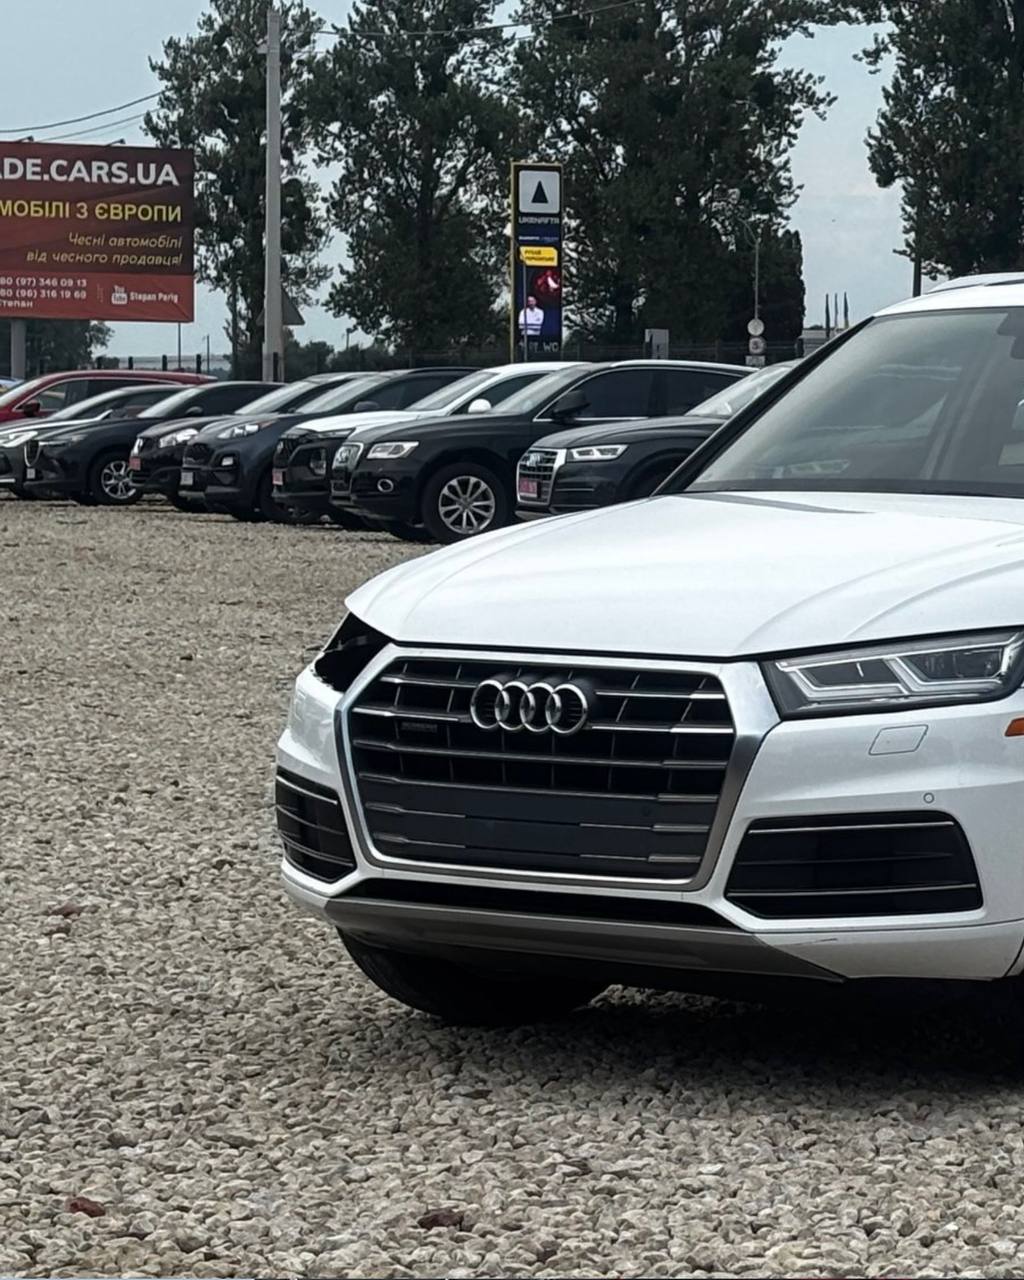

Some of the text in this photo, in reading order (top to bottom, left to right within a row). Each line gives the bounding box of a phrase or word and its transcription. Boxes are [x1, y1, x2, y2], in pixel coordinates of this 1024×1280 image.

[0, 157, 180, 186] DE.CARS.UA
[76, 203, 88, 219] З
[95, 203, 182, 222] ЄВРОПИ
[69, 232, 183, 248] Чесні автомобілі
[26, 249, 183, 266] від чесного продавця!
